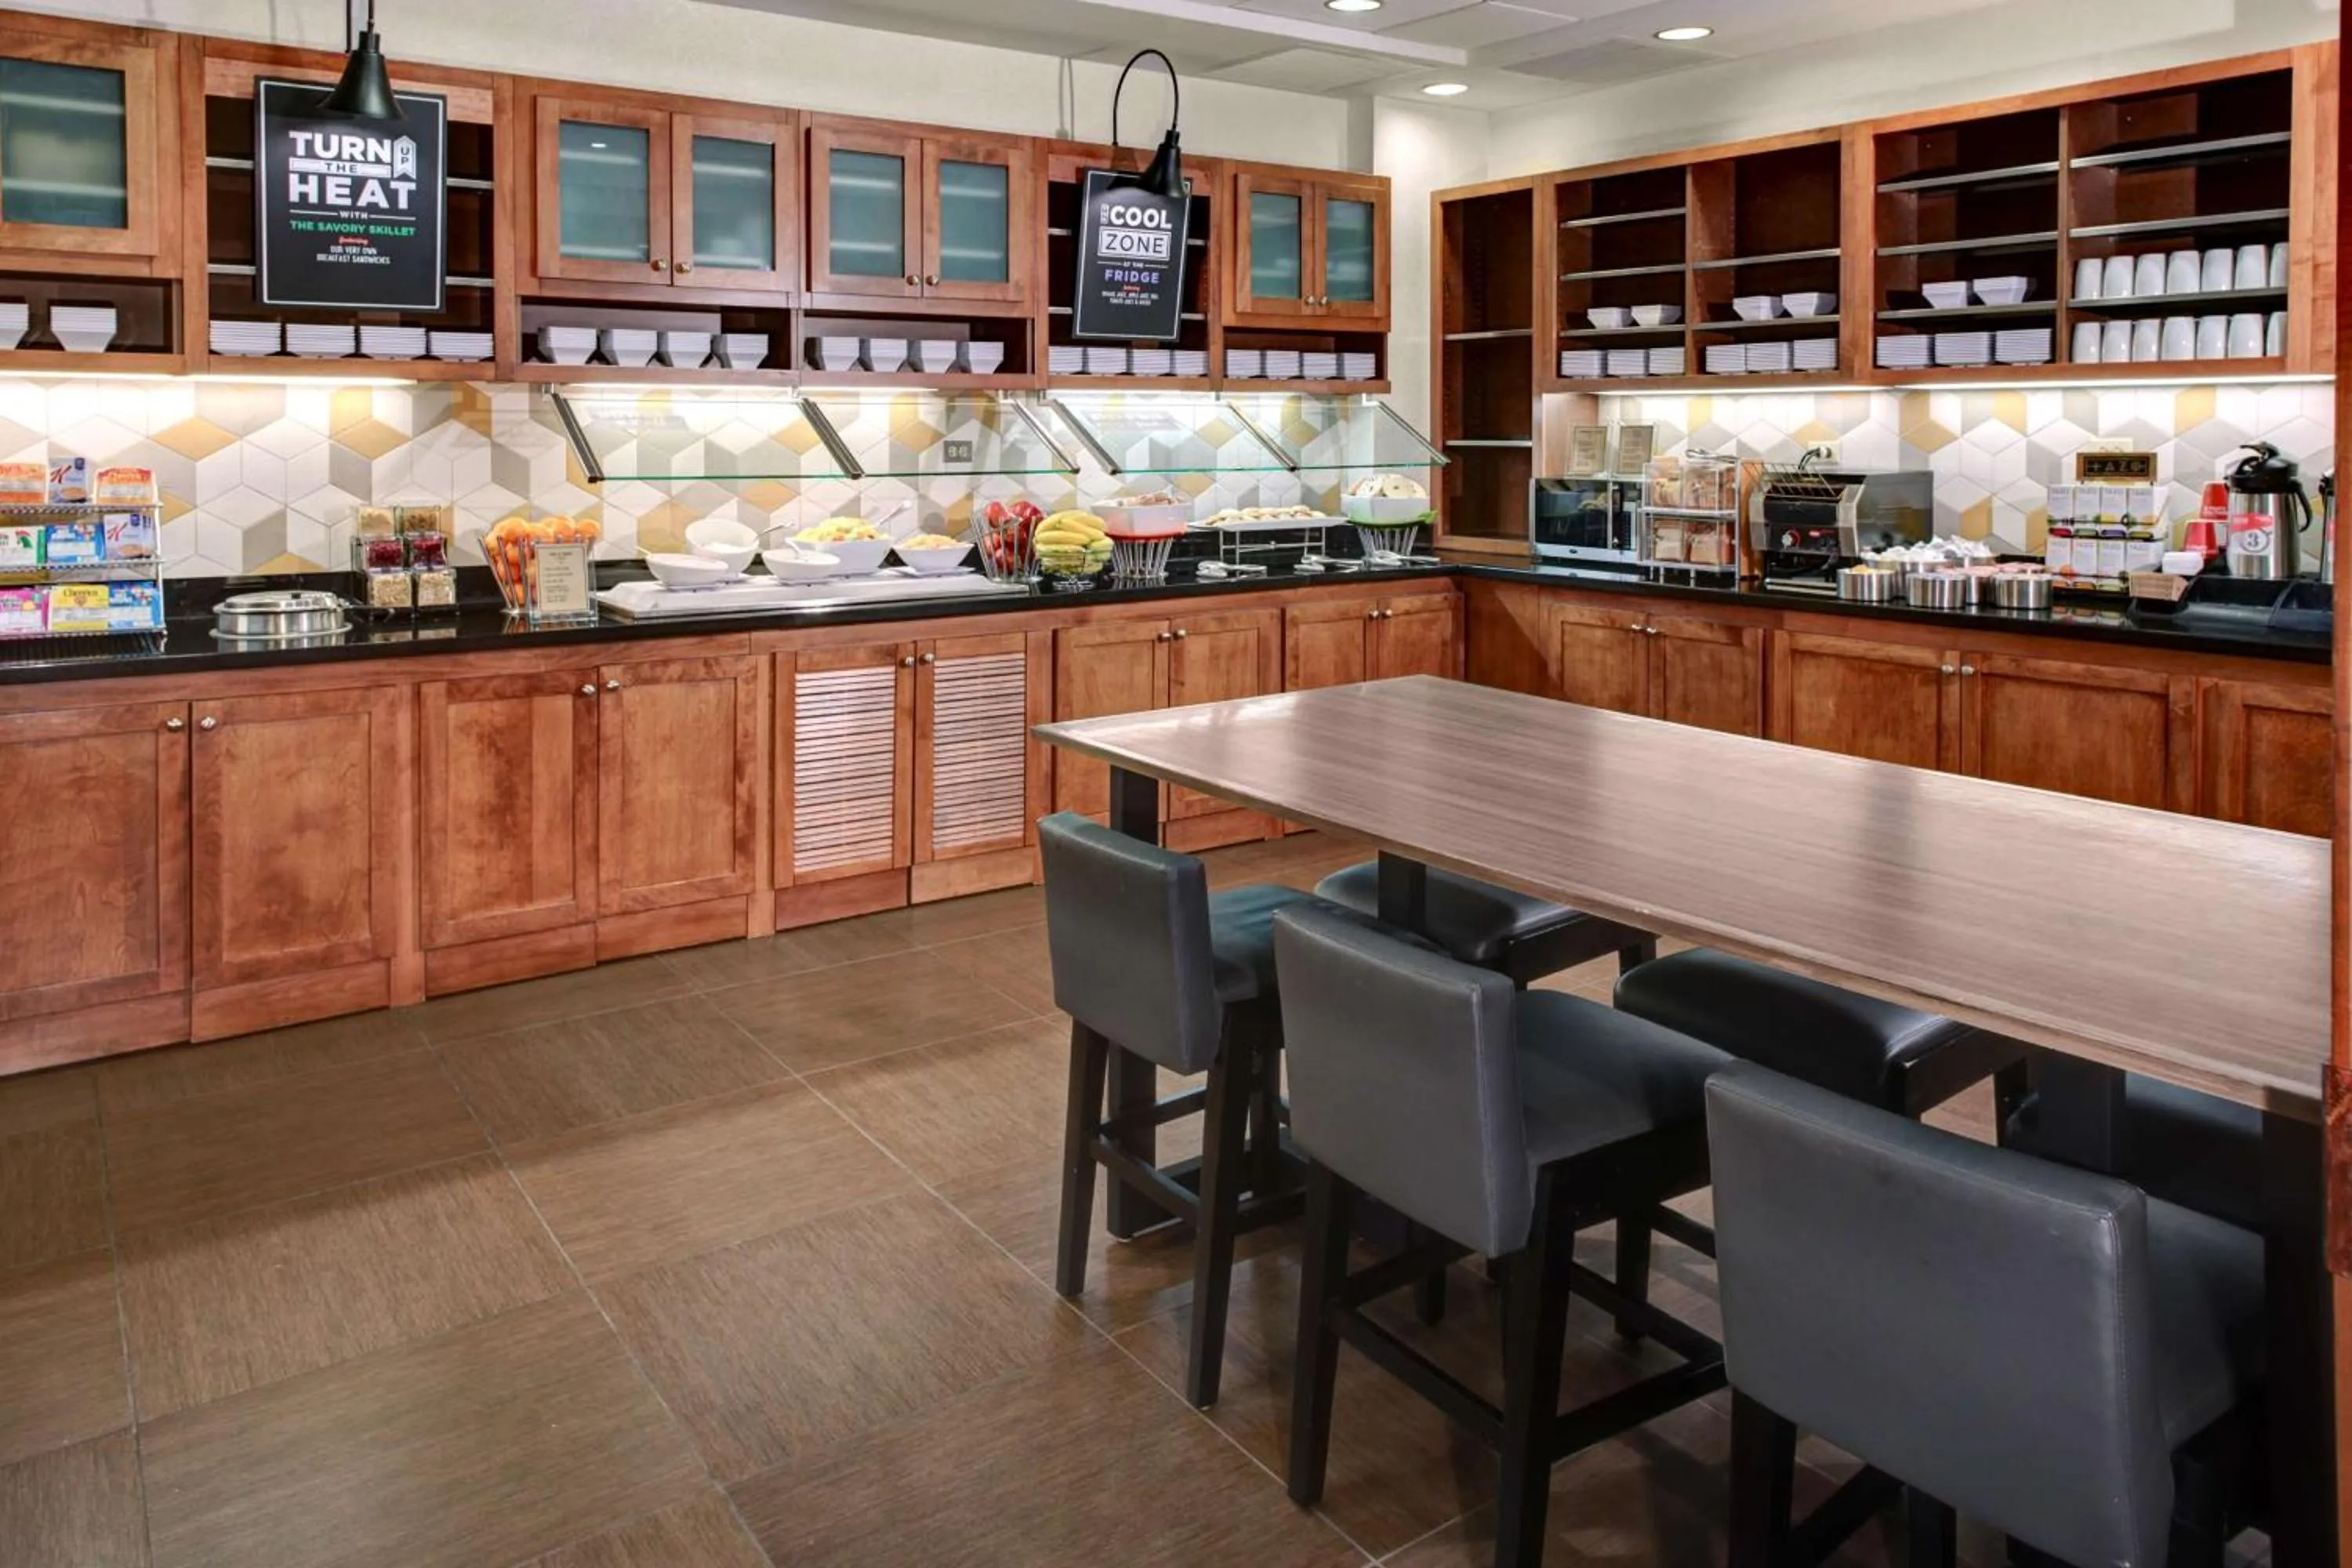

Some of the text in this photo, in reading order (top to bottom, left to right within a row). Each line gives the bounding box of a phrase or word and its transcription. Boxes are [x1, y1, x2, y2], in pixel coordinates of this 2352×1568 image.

[289, 130, 391, 163] TURN
[401, 147, 410, 165] UP
[325, 162, 358, 173] THE
[289, 172, 416, 209] HEAT
[339, 210, 368, 220] WITH
[1110, 205, 1173, 229] COOL
[289, 220, 416, 236] THE SAVORY SKILLET
[1105, 233, 1164, 254] ZONE
[1105, 269, 1160, 284] FRIDGE
[2247, 532, 2259, 547] 3
